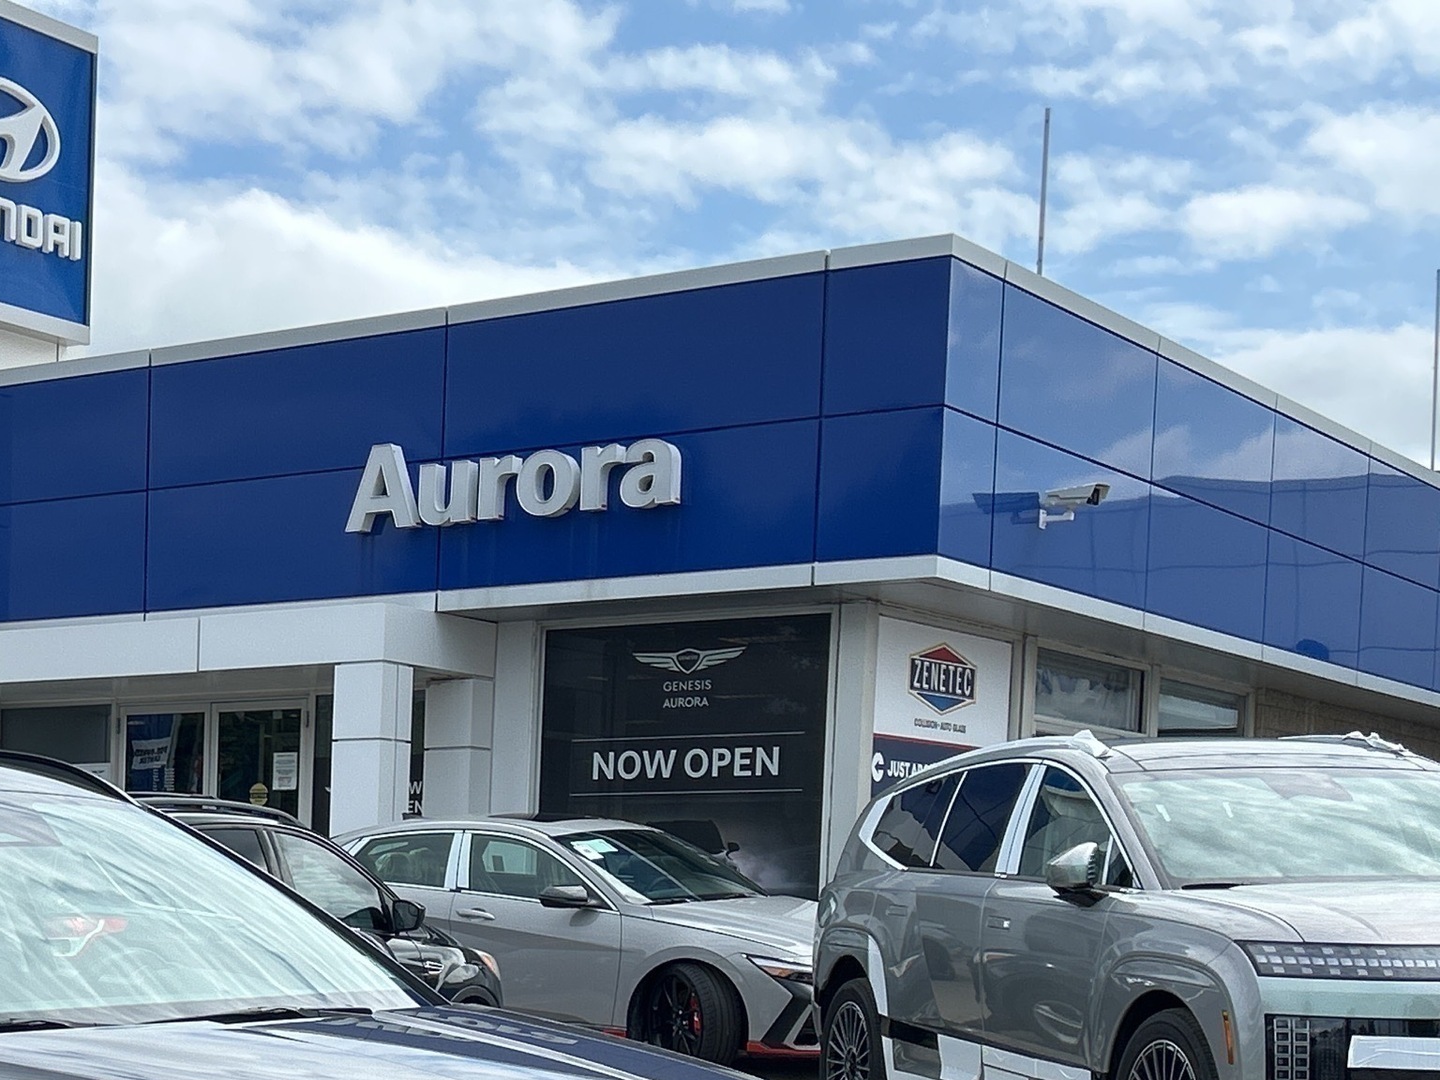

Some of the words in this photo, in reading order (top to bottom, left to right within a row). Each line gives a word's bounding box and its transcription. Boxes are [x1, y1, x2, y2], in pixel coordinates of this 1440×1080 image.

[344, 437, 682, 533] Aurora
[663, 679, 712, 692] GENESIS
[913, 659, 973, 697] ZENETEC
[662, 696, 710, 709] AURORA
[592, 749, 677, 781] NOW
[683, 746, 780, 778] OPEN
[887, 760, 910, 778] JUST
